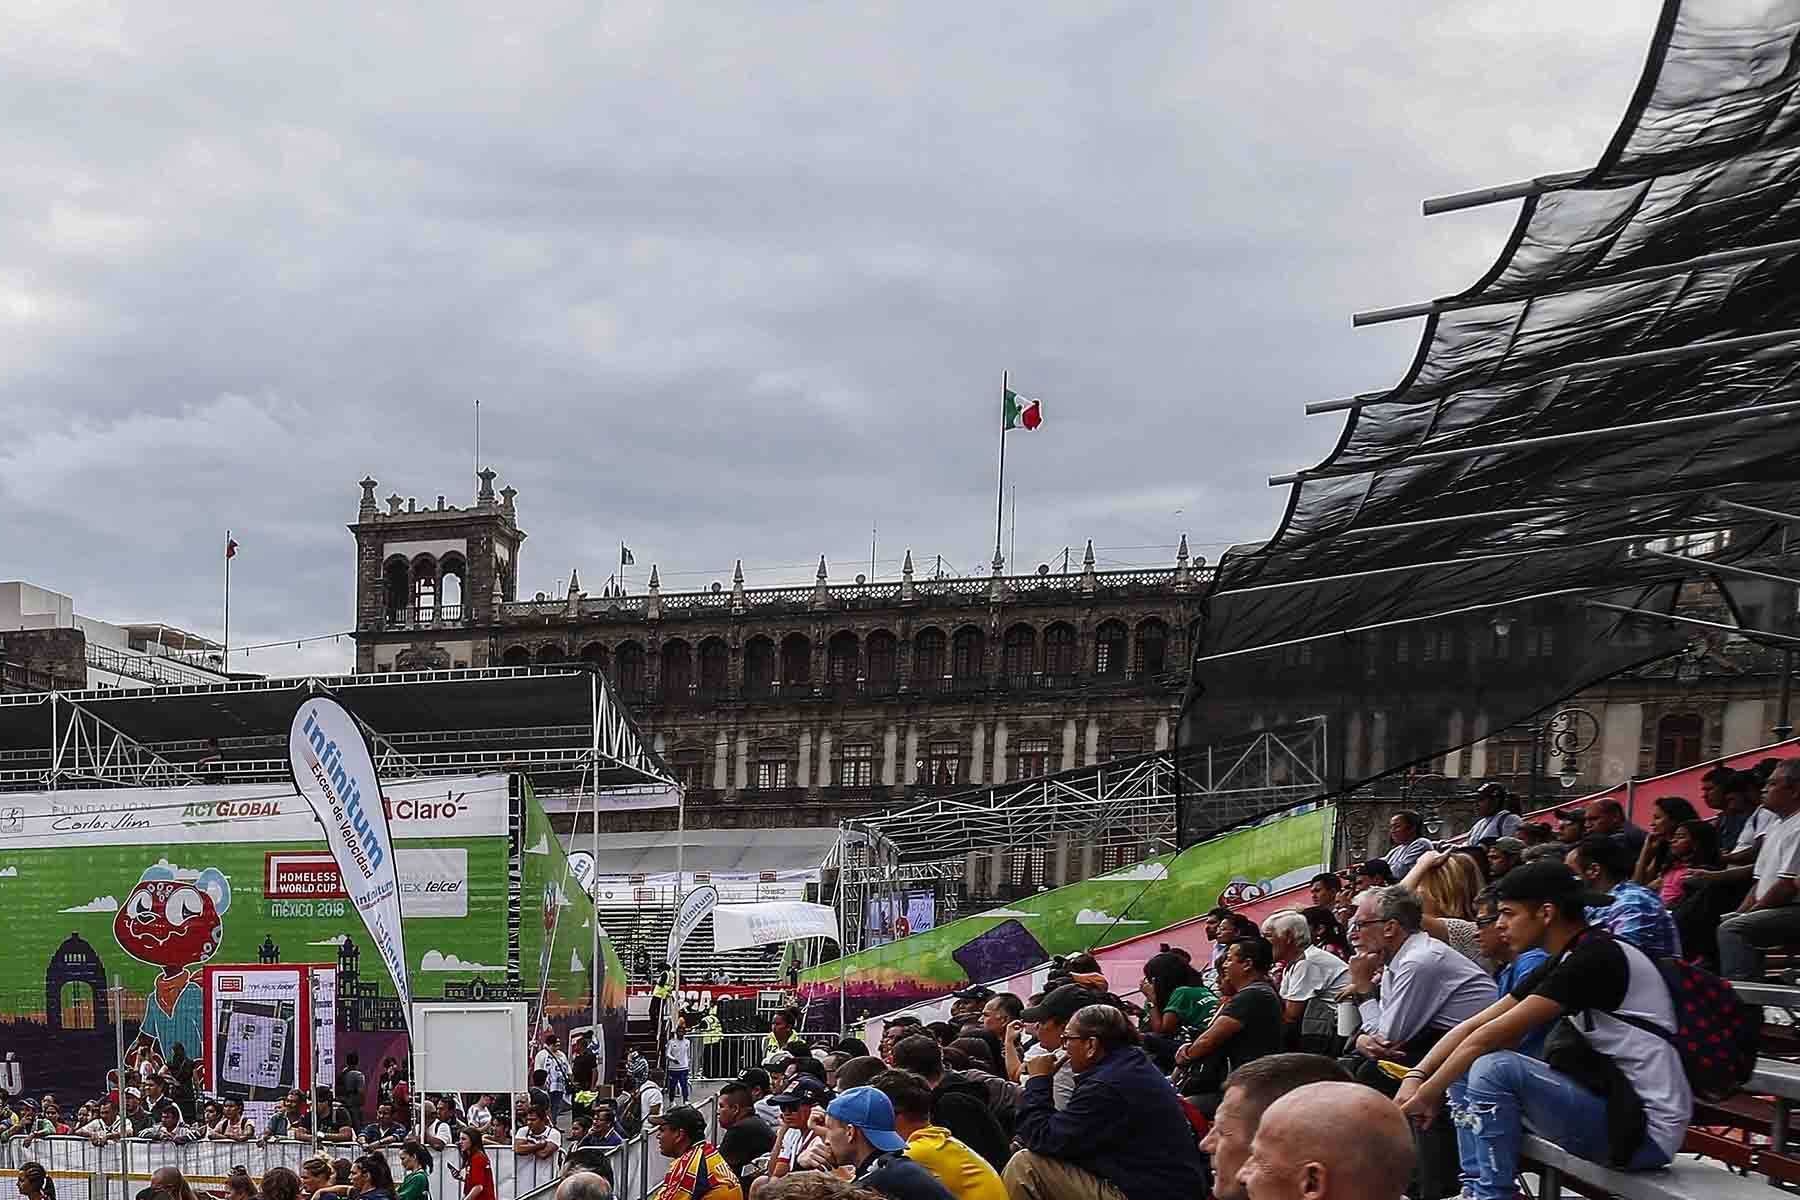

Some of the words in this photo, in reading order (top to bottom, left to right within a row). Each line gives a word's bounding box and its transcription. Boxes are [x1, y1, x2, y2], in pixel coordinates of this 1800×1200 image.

[302, 708, 385, 872] infinitum
[396, 794, 460, 820] Claro
[311, 762, 336, 805] Exceso
[332, 805, 344, 822] de
[339, 821, 374, 880] Velocidad
[280, 872, 337, 882] HOMELESS
[280, 883, 316, 893] WORLD
[318, 883, 337, 893] CUP
[425, 880, 462, 893] telcel
[317, 902, 345, 917] 2018
